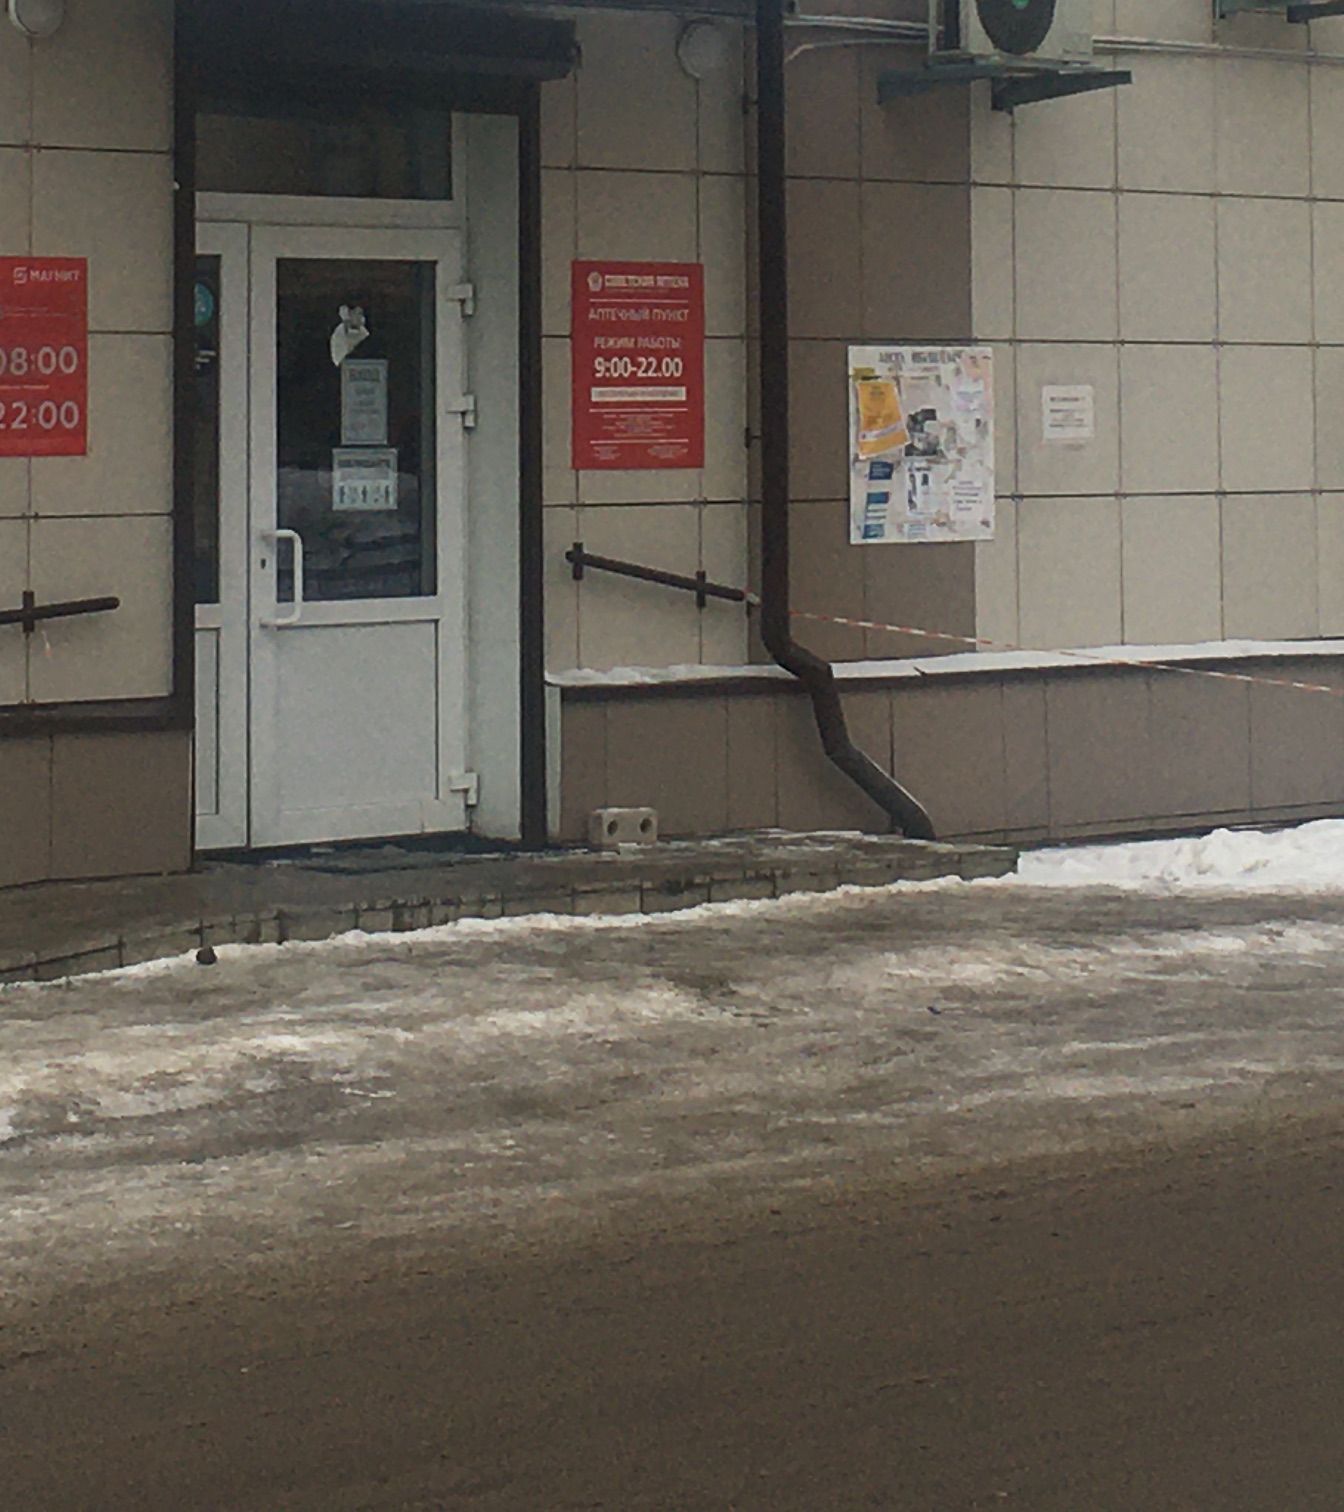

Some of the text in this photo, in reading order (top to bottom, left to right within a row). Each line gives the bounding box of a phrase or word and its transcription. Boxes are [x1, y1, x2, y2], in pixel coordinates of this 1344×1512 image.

[29, 269, 80, 282] МАГНИТ
[588, 306, 690, 321] АПТЕЧНЫЙ ПУНКТ
[593, 336, 636, 349] РЕЖИМ
[594, 356, 684, 379] 9:00-22.00
